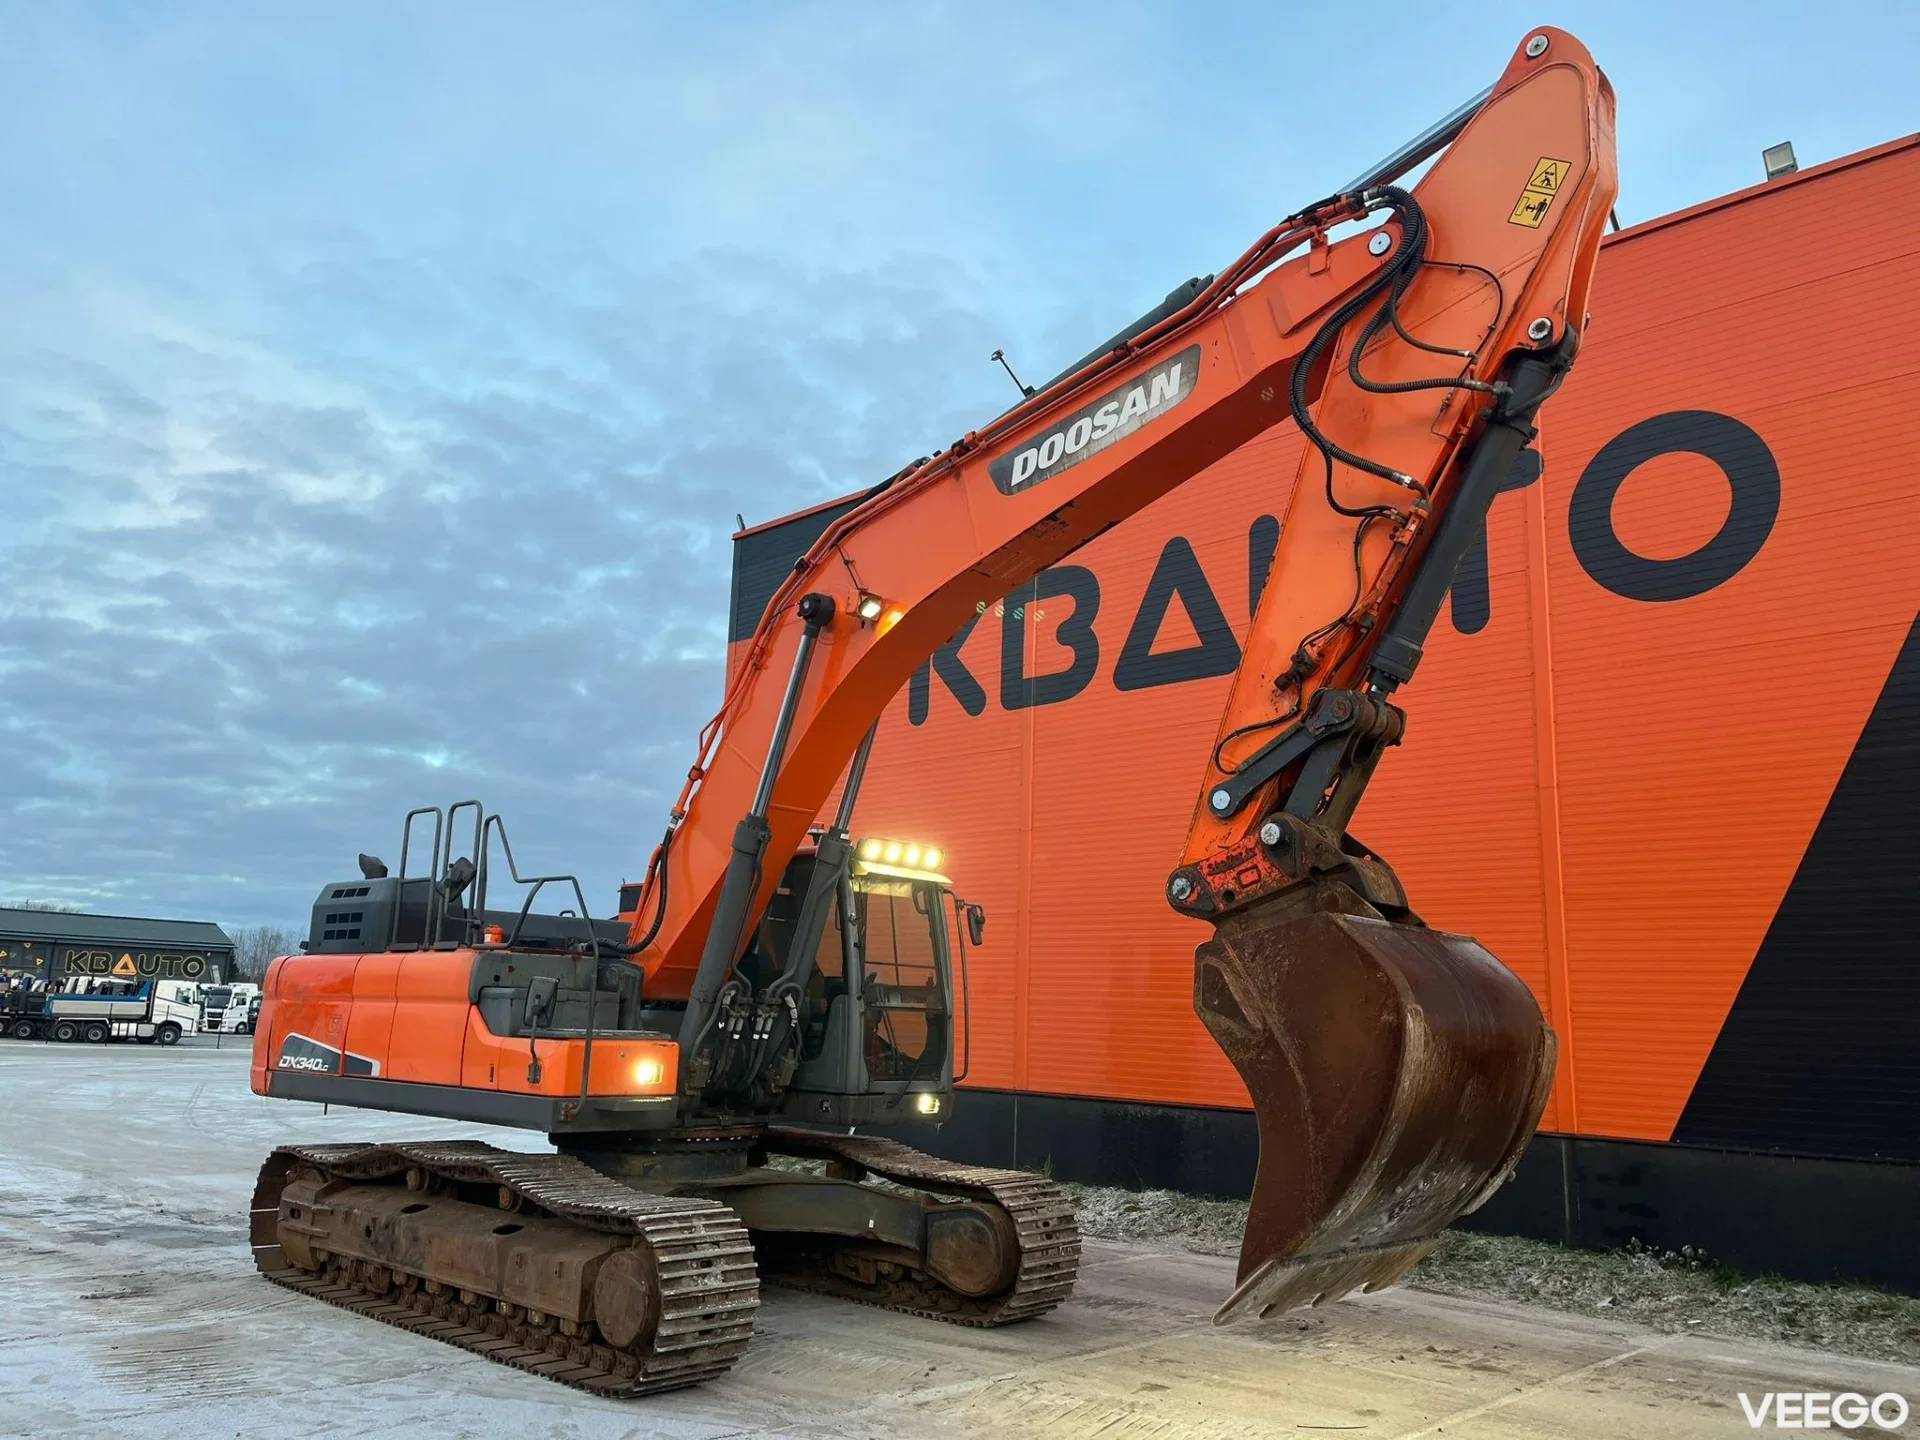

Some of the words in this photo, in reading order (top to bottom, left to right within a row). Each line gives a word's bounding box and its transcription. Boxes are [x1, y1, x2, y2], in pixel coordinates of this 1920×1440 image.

[1010, 362, 1182, 487] DOOSAN
[908, 410, 1782, 727] KBAO
[65, 950, 206, 979] KBAUTO
